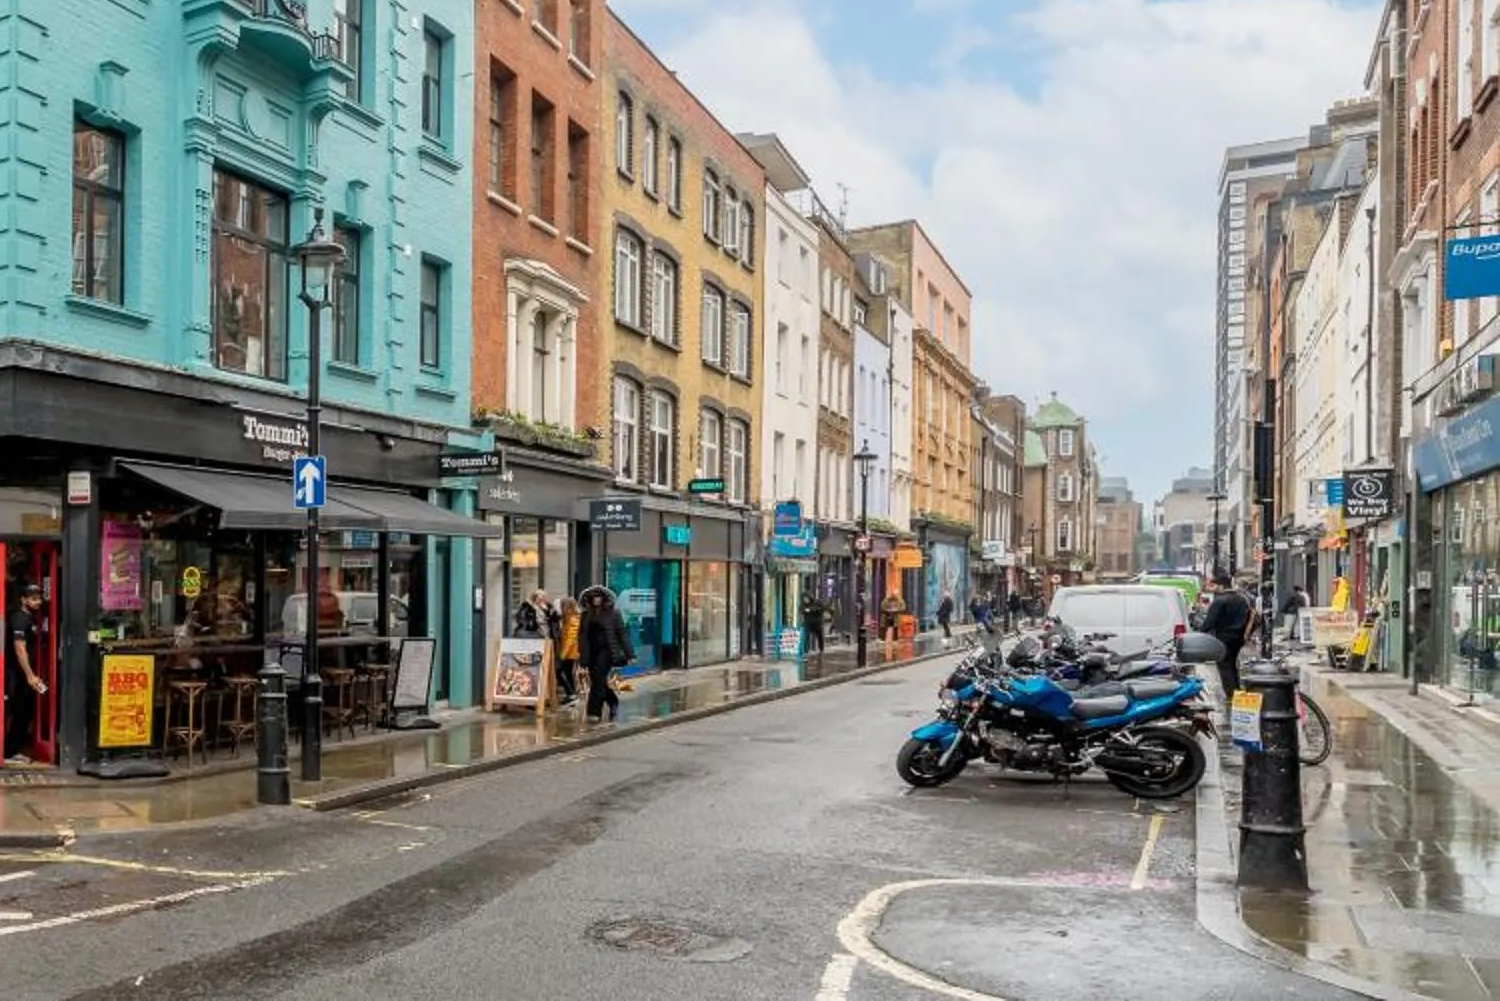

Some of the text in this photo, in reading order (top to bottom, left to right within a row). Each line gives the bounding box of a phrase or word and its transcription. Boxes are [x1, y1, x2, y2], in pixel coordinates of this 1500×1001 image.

[1452, 242, 1500, 256] Bupa
[441, 454, 499, 468] Tommi's
[1348, 504, 1387, 516] Vinyl
